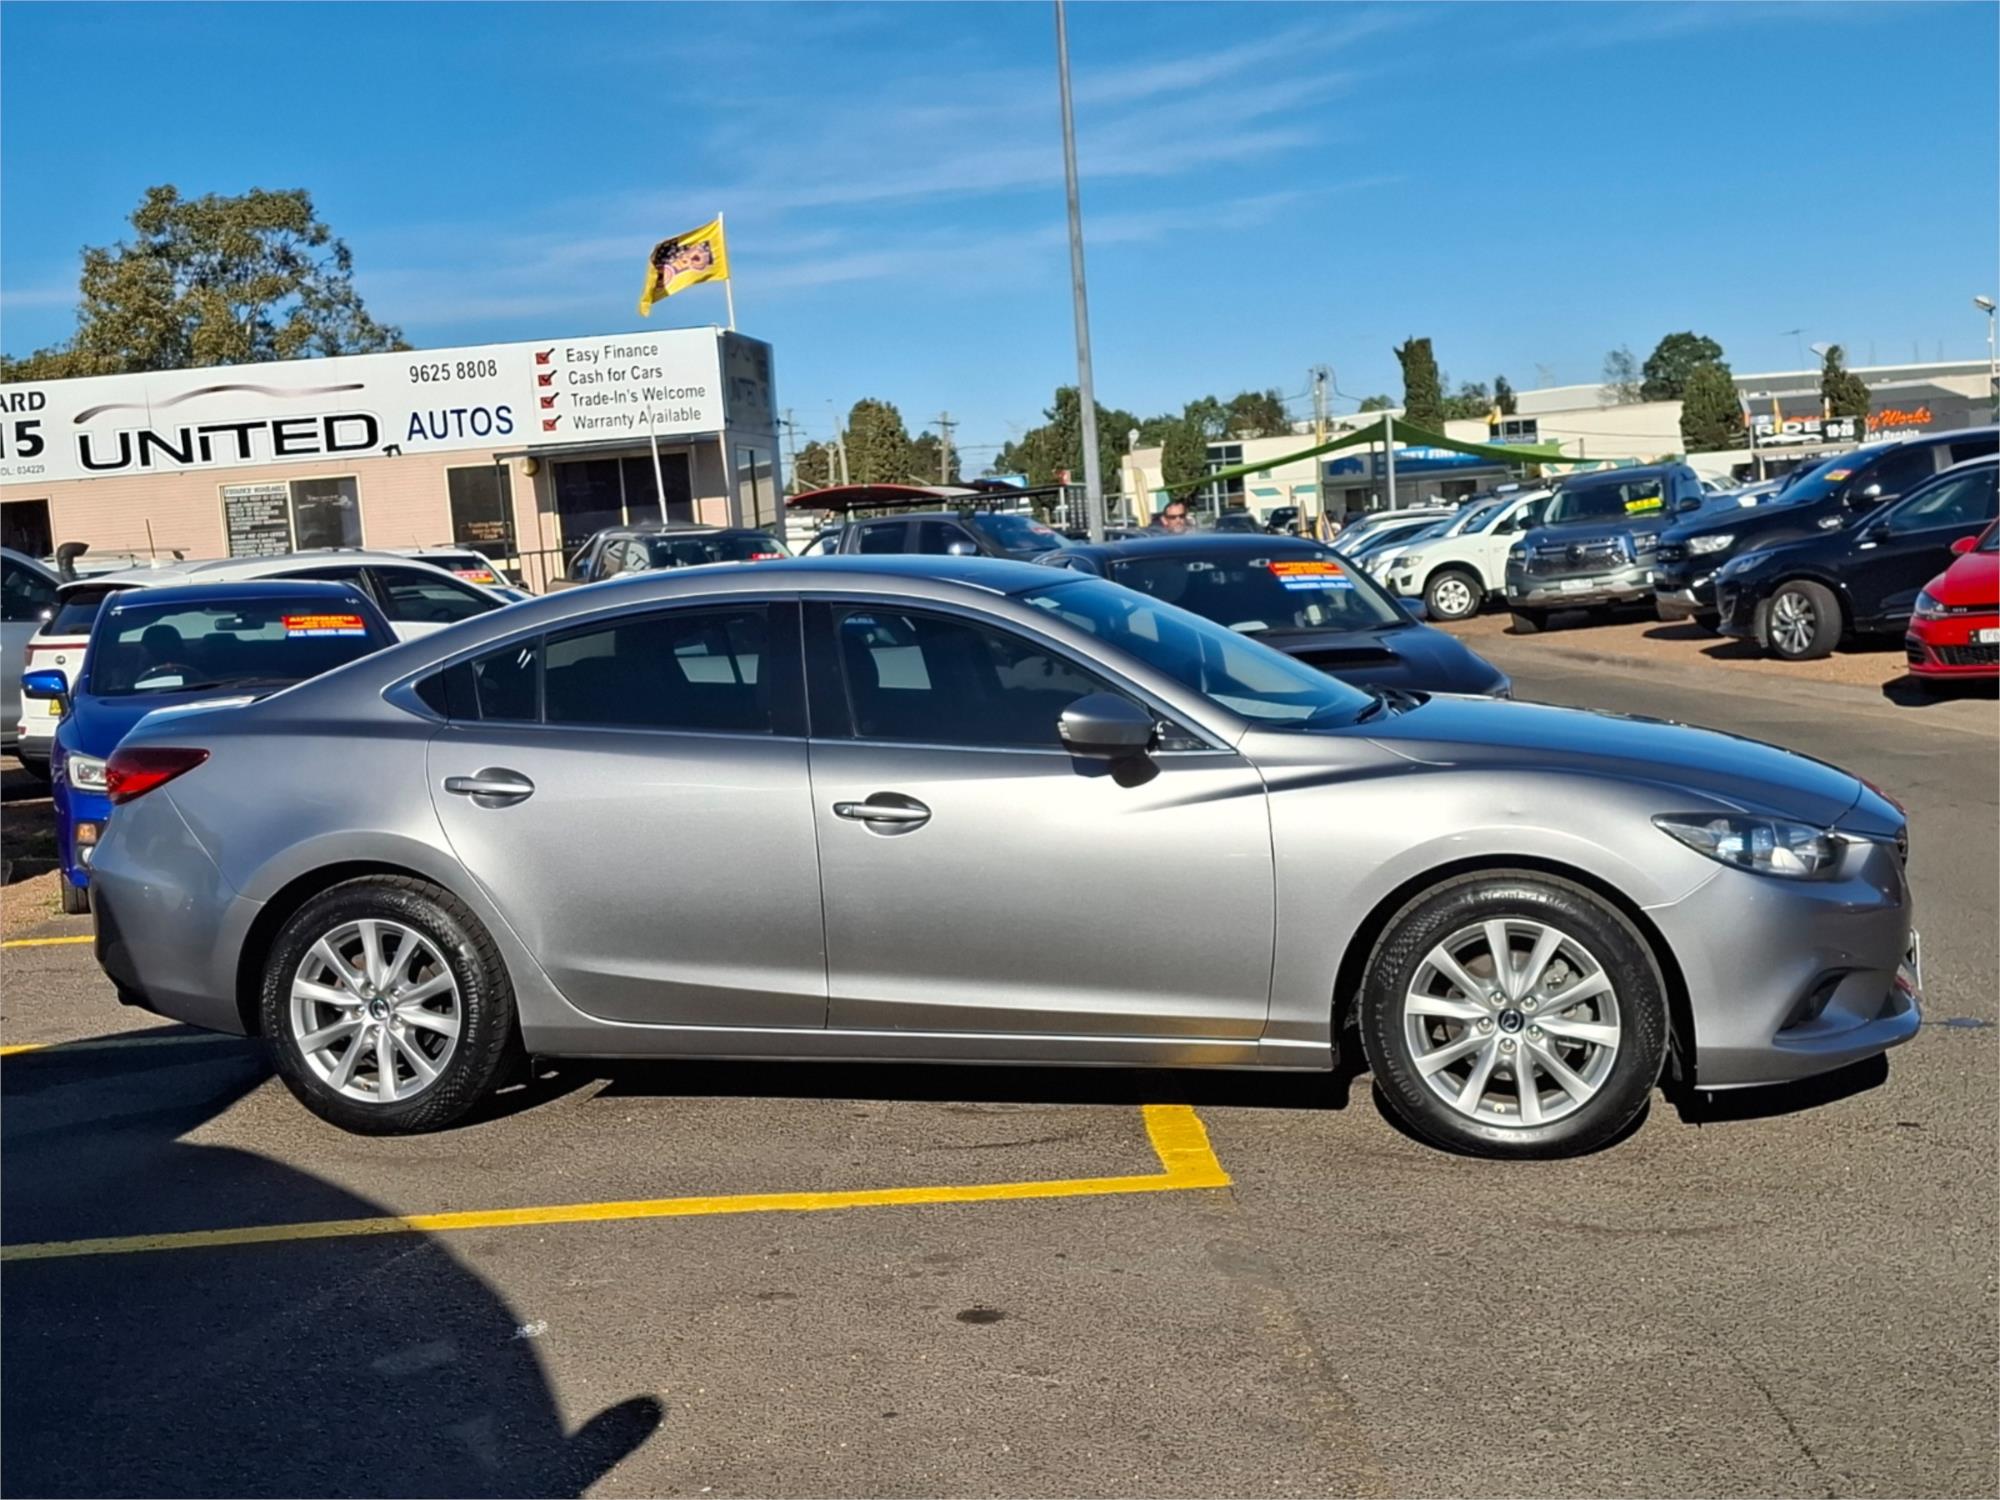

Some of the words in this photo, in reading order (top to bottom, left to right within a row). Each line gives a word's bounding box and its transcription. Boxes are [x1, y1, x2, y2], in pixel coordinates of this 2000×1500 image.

[566, 347, 599, 364] Easy
[604, 344, 659, 359] Finance
[409, 364, 451, 383] 9625
[456, 359, 497, 379] 8808
[568, 369, 604, 385] Cash
[607, 367, 627, 382] for
[630, 365, 663, 380] Cars
[571, 389, 639, 407] Trade-In's
[642, 385, 706, 402] Welcome
[573, 413, 635, 430] Warranty
[638, 406, 702, 425] Available
[78, 413, 379, 470] UNITED
[407, 405, 513, 441] AUTOS
